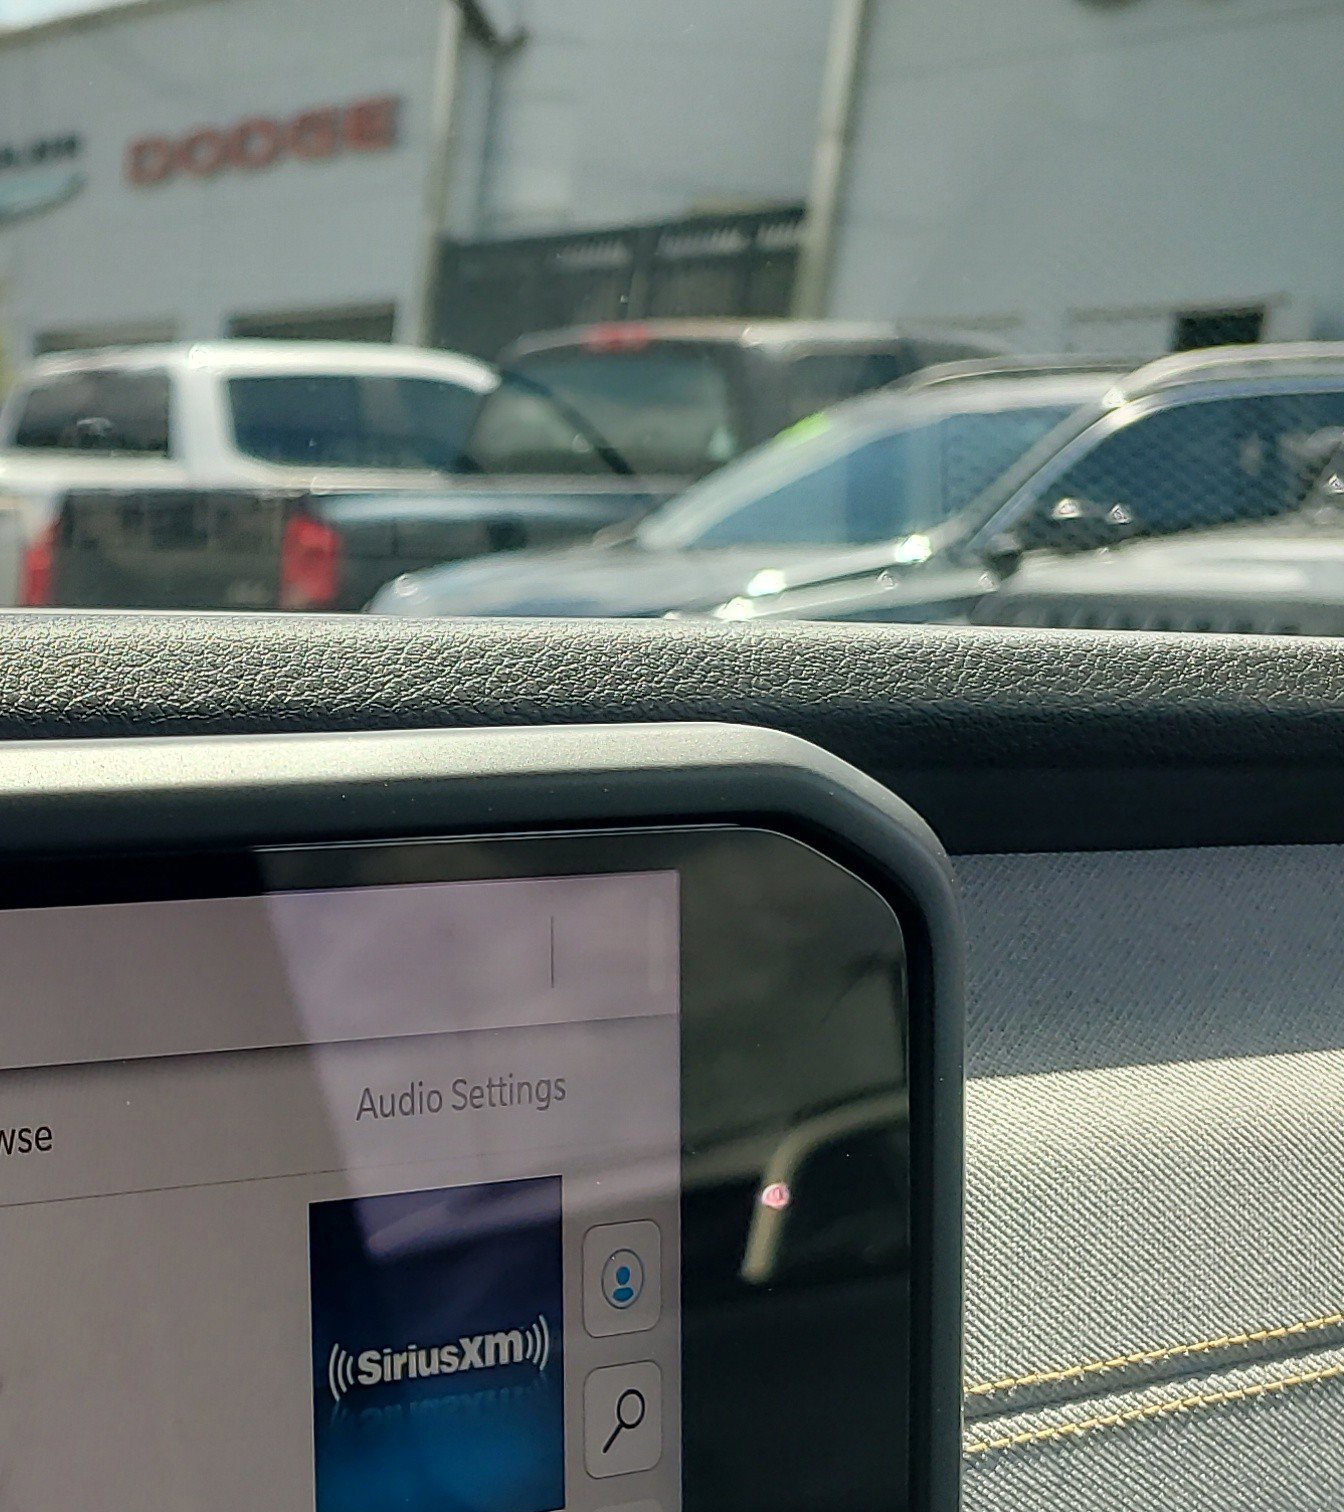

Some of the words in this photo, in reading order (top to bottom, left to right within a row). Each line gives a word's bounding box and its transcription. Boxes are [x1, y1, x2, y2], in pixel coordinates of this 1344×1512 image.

[124, 93, 402, 188] DODGE
[356, 1080, 443, 1121] Audio
[451, 1072, 567, 1113] Settings
